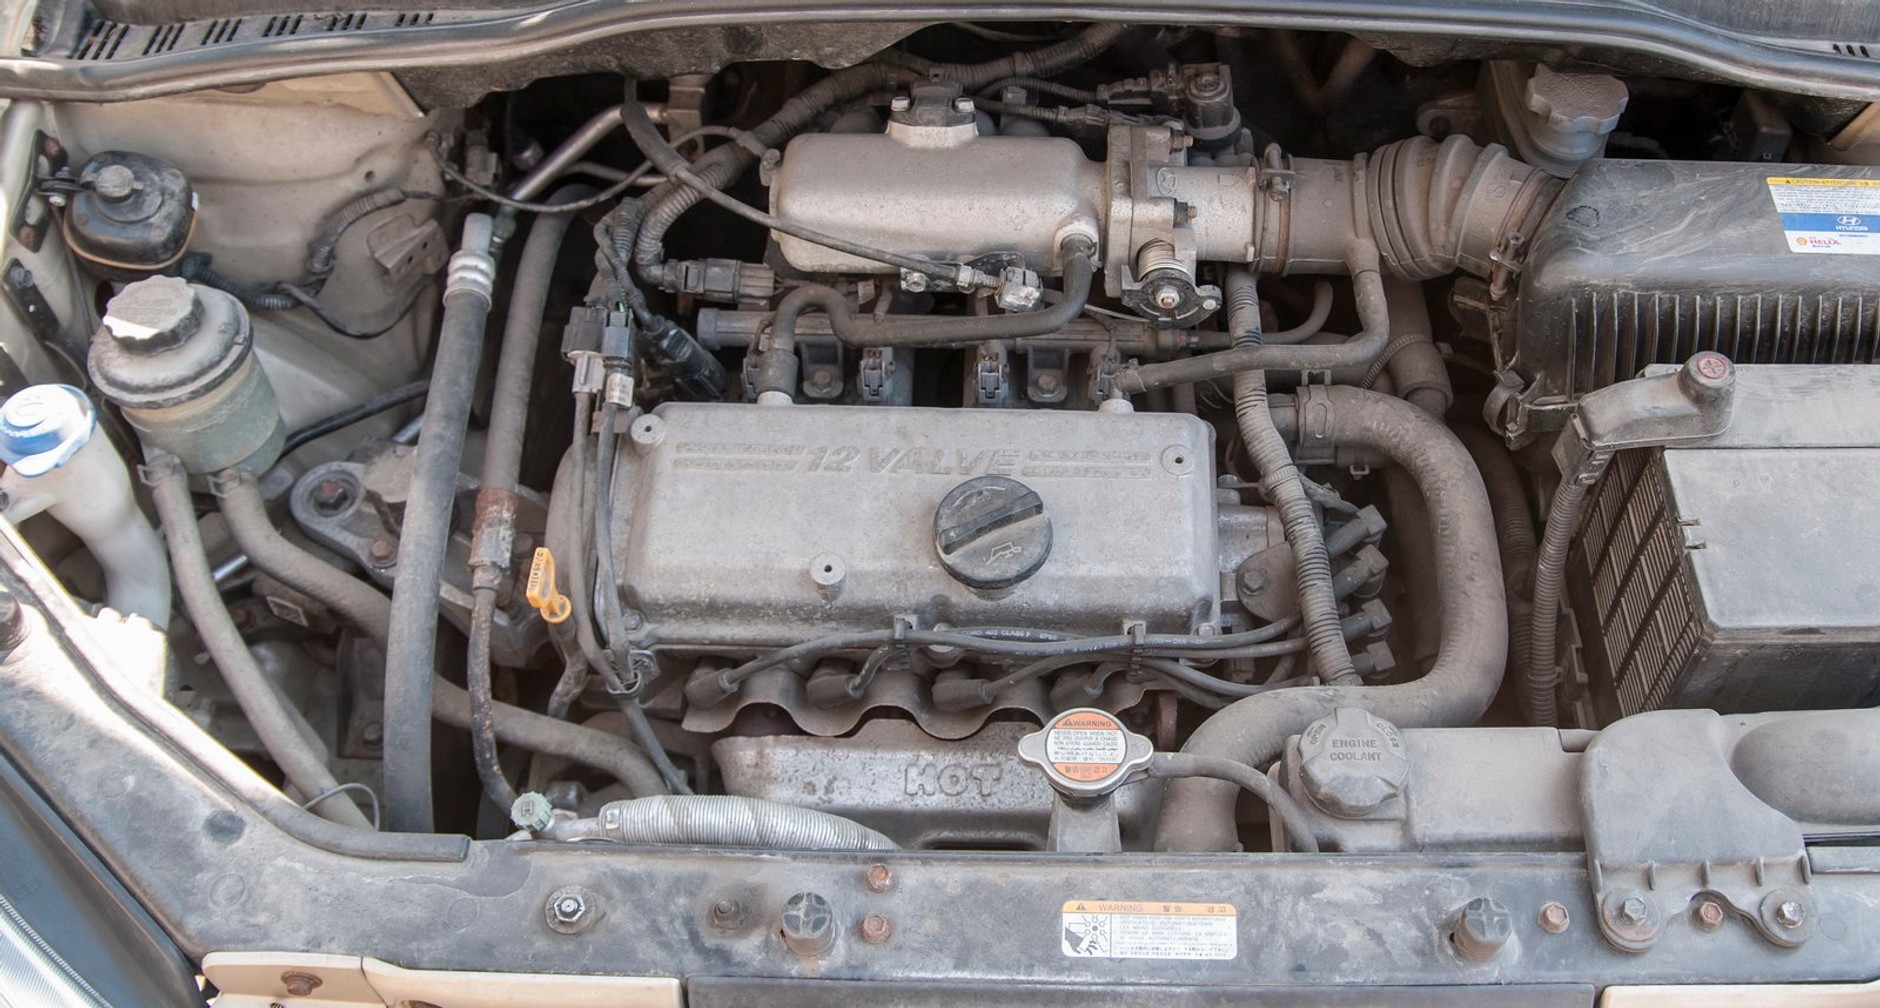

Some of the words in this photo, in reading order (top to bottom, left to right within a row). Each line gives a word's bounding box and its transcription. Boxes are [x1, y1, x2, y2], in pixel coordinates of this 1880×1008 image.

[806, 446, 860, 473] 12
[867, 447, 1020, 476] VALVE
[1332, 739, 1377, 749] ENGINE
[1329, 752, 1382, 762] COOLANT
[903, 763, 1003, 797] HOT
[1098, 904, 1143, 912] WARNING
